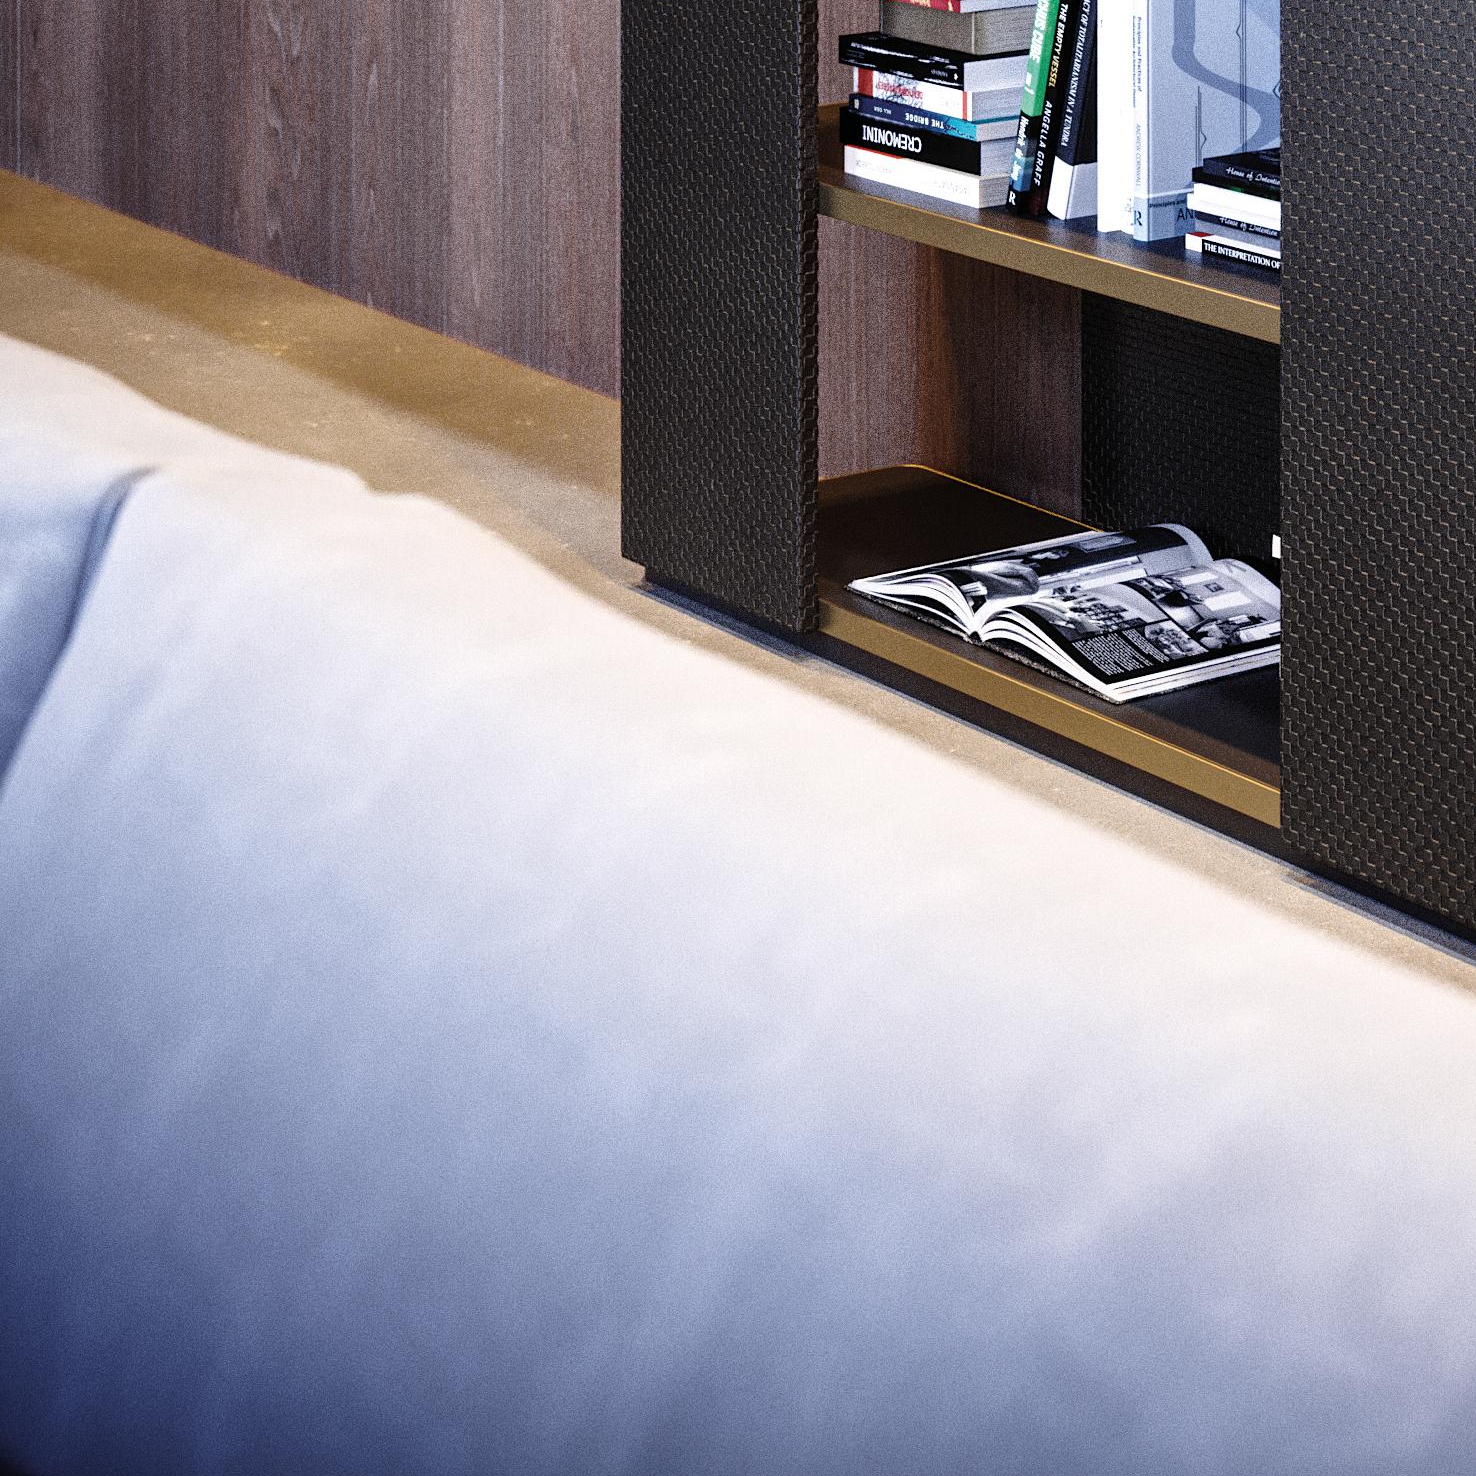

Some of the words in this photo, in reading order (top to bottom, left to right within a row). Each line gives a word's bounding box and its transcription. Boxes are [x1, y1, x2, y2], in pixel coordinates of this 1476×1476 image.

[1058, 3, 1069, 23] THE
[1080, 14, 1089, 26] OF
[1029, 29, 1044, 64] CUBE
[1054, 21, 1066, 60] EMPTY
[1048, 54, 1060, 87] VESSEL
[1068, 25, 1088, 95] TOTALITARIANISM
[1067, 94, 1076, 106] IN
[905, 112, 929, 126] BRIDGE
[931, 118, 945, 129] THE
[1017, 115, 1030, 146] Hendrik
[1038, 100, 1053, 148] ANGELLA
[1060, 113, 1073, 147] TUNDRA
[862, 124, 922, 153] CREMONINI
[1033, 150, 1045, 186] GRAFF
[1225, 166, 1245, 177] House
[1245, 171, 1254, 182] of
[1008, 191, 1017, 206] R
[1133, 210, 1143, 227] R
[1204, 242, 1217, 253] THE
[1217, 245, 1271, 267] INTERPRETATION
[1270, 259, 1280, 269] OF
